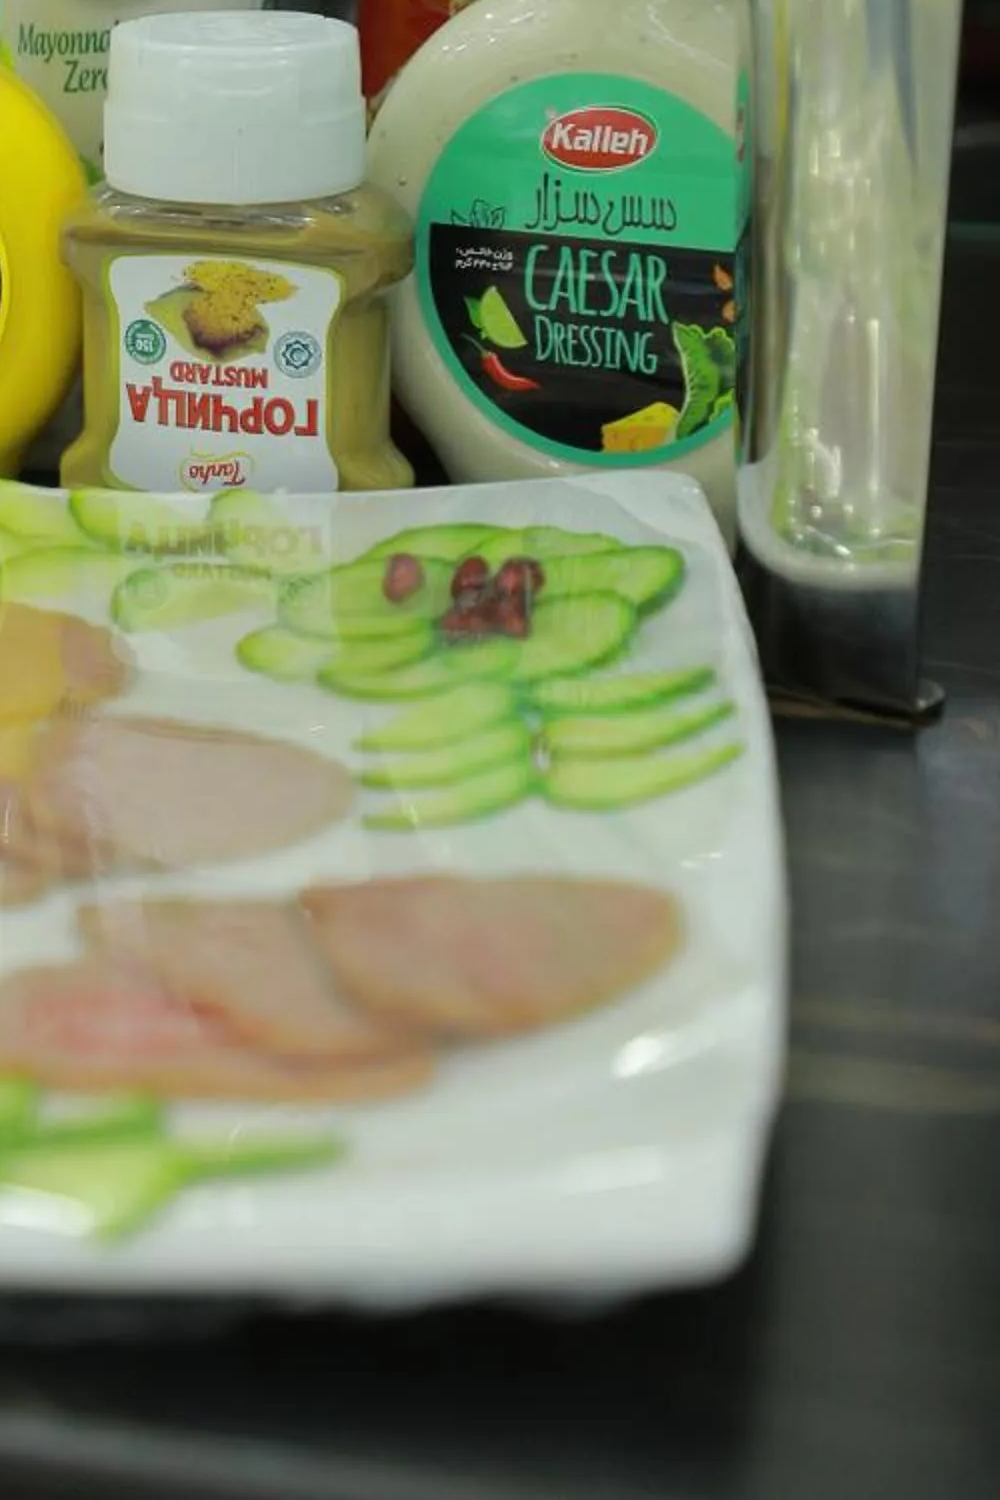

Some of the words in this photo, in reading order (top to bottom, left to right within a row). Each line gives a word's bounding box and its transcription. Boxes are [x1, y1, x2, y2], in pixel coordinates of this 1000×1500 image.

[17, 20, 119, 63] Mayonna
[551, 121, 648, 156] Kalleh
[524, 244, 669, 324] CAESAR
[534, 315, 659, 375] DRESSING
[169, 361, 268, 389] MUSTARD
[125, 376, 319, 437] ГОРЧИЦА
